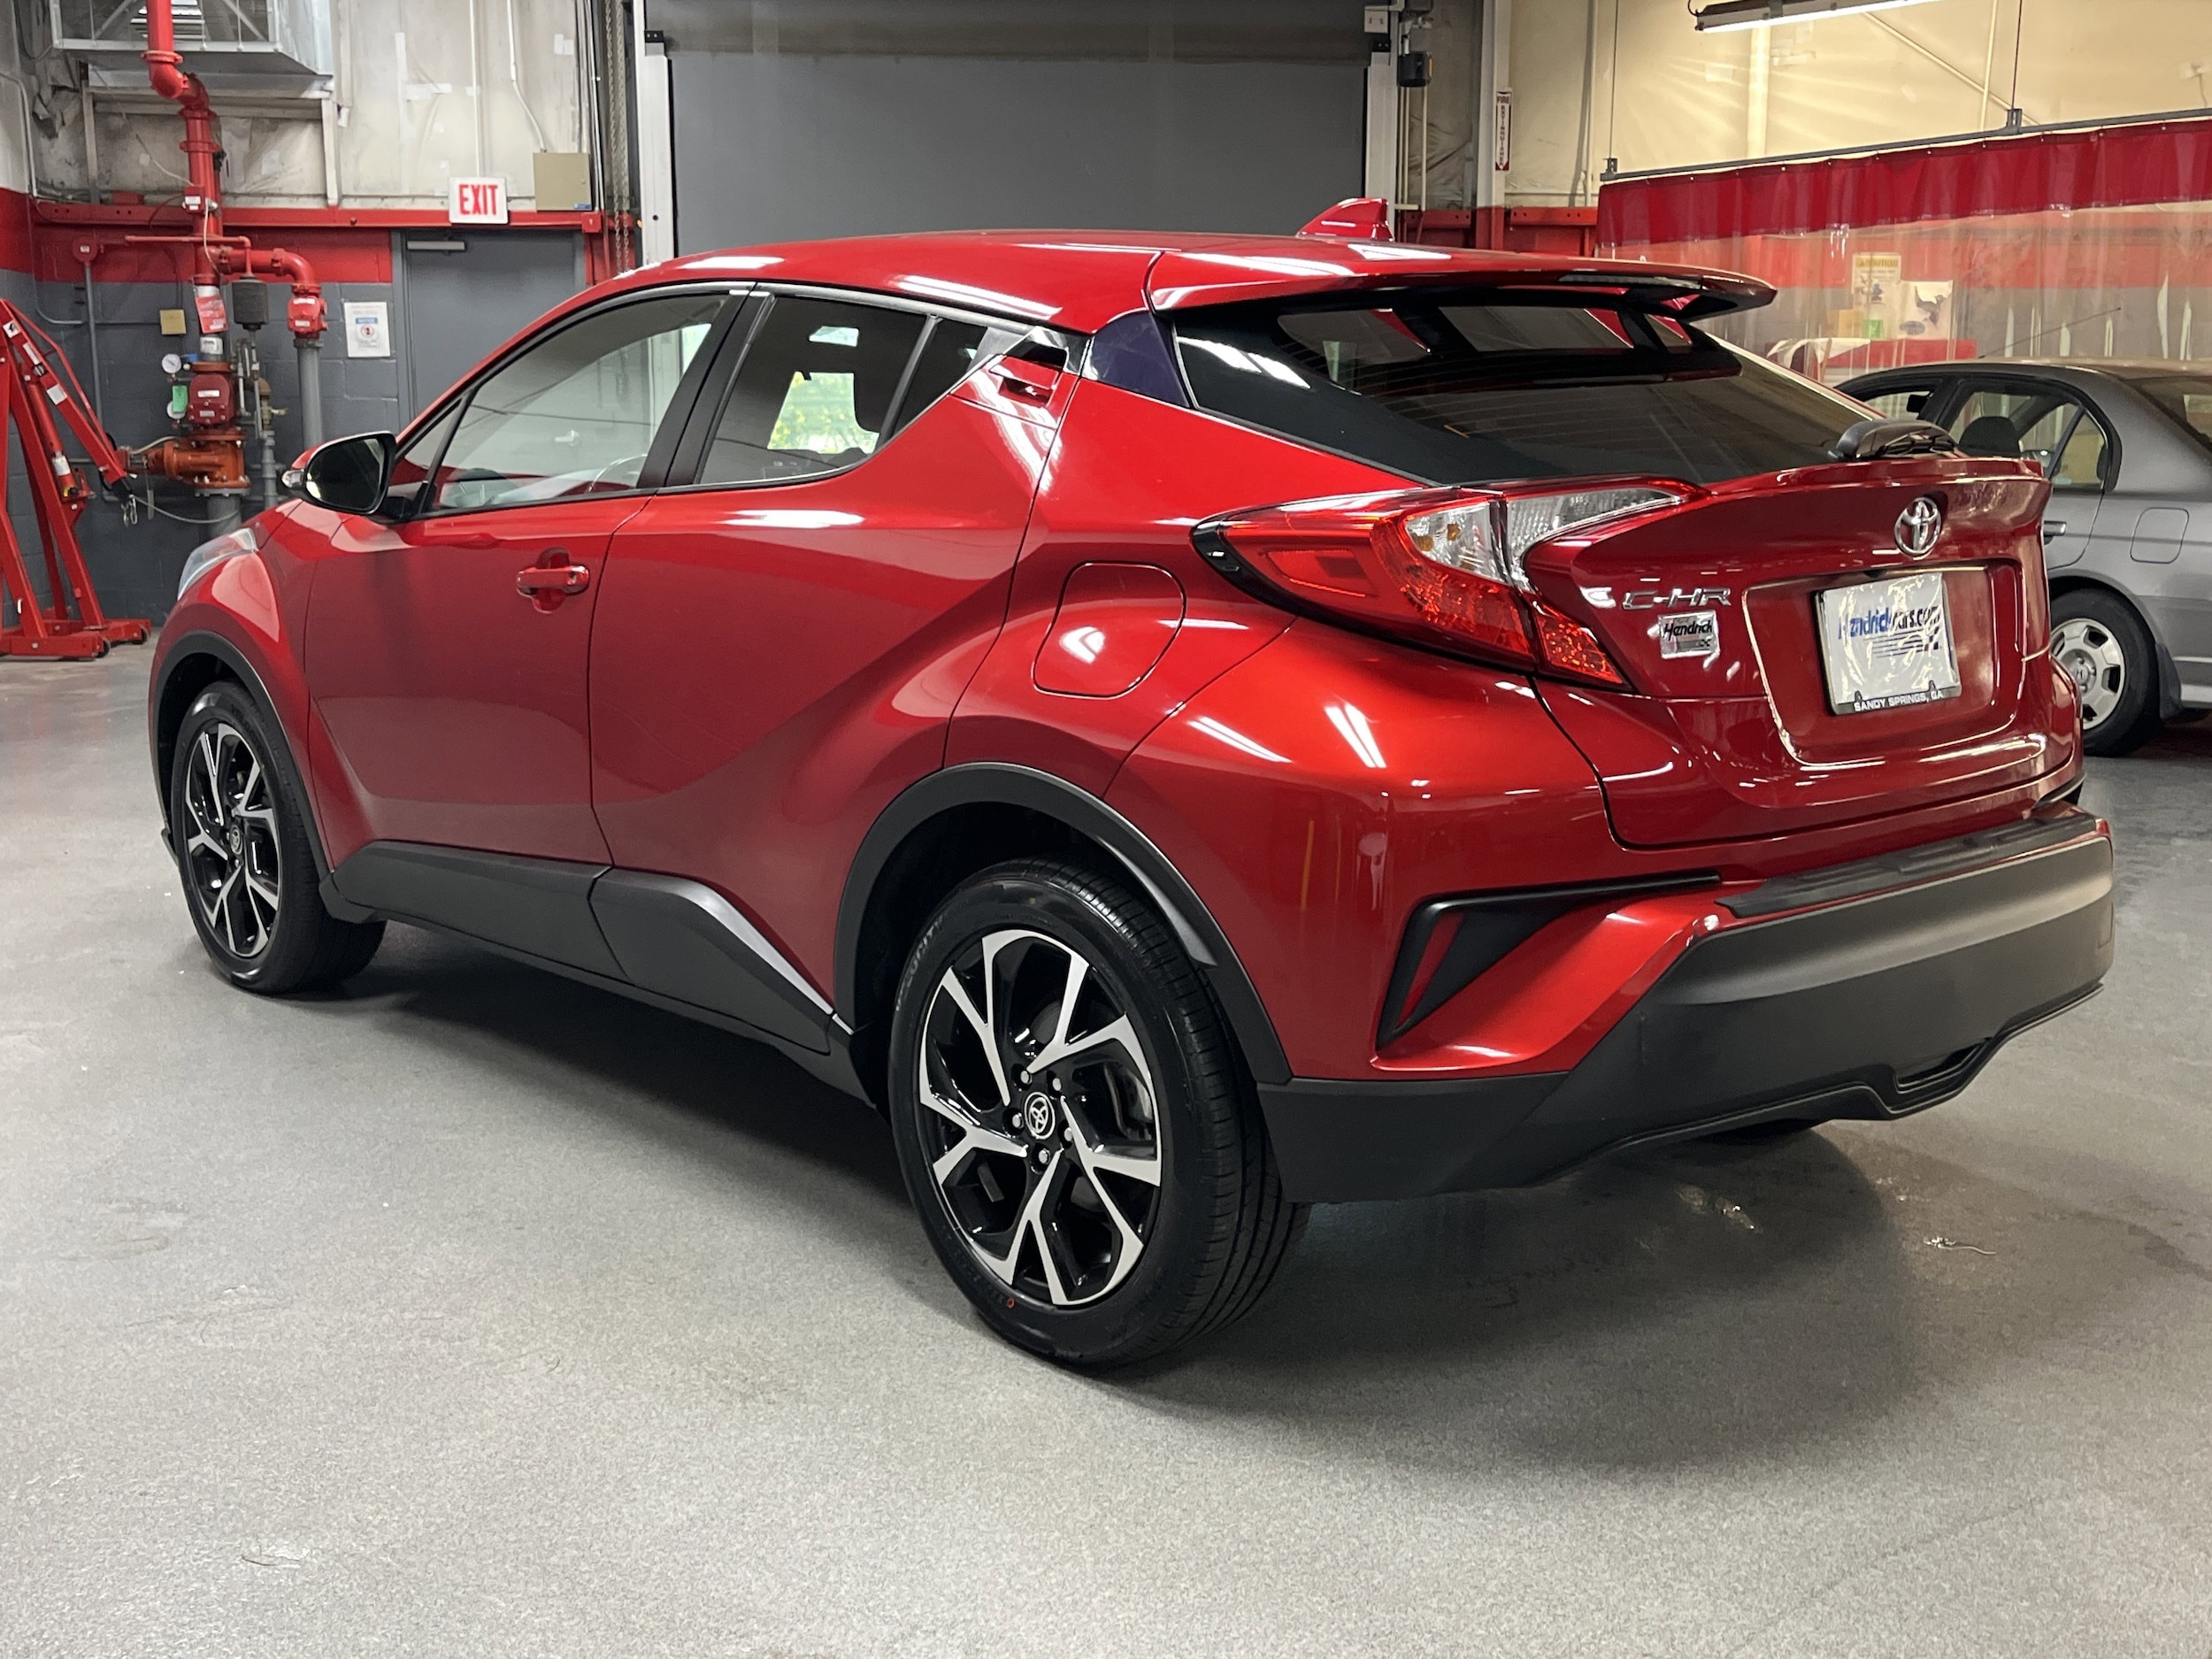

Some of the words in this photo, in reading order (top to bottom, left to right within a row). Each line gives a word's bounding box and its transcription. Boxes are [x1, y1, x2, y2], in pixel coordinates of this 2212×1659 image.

[458, 184, 498, 215] EXIT
[1623, 588, 1732, 610] C-HR
[1663, 619, 1712, 641] Hendrick
[1854, 698, 1886, 711] SANDY
[1888, 692, 1930, 707] SPRINGS,
[1931, 690, 1944, 701] GA
